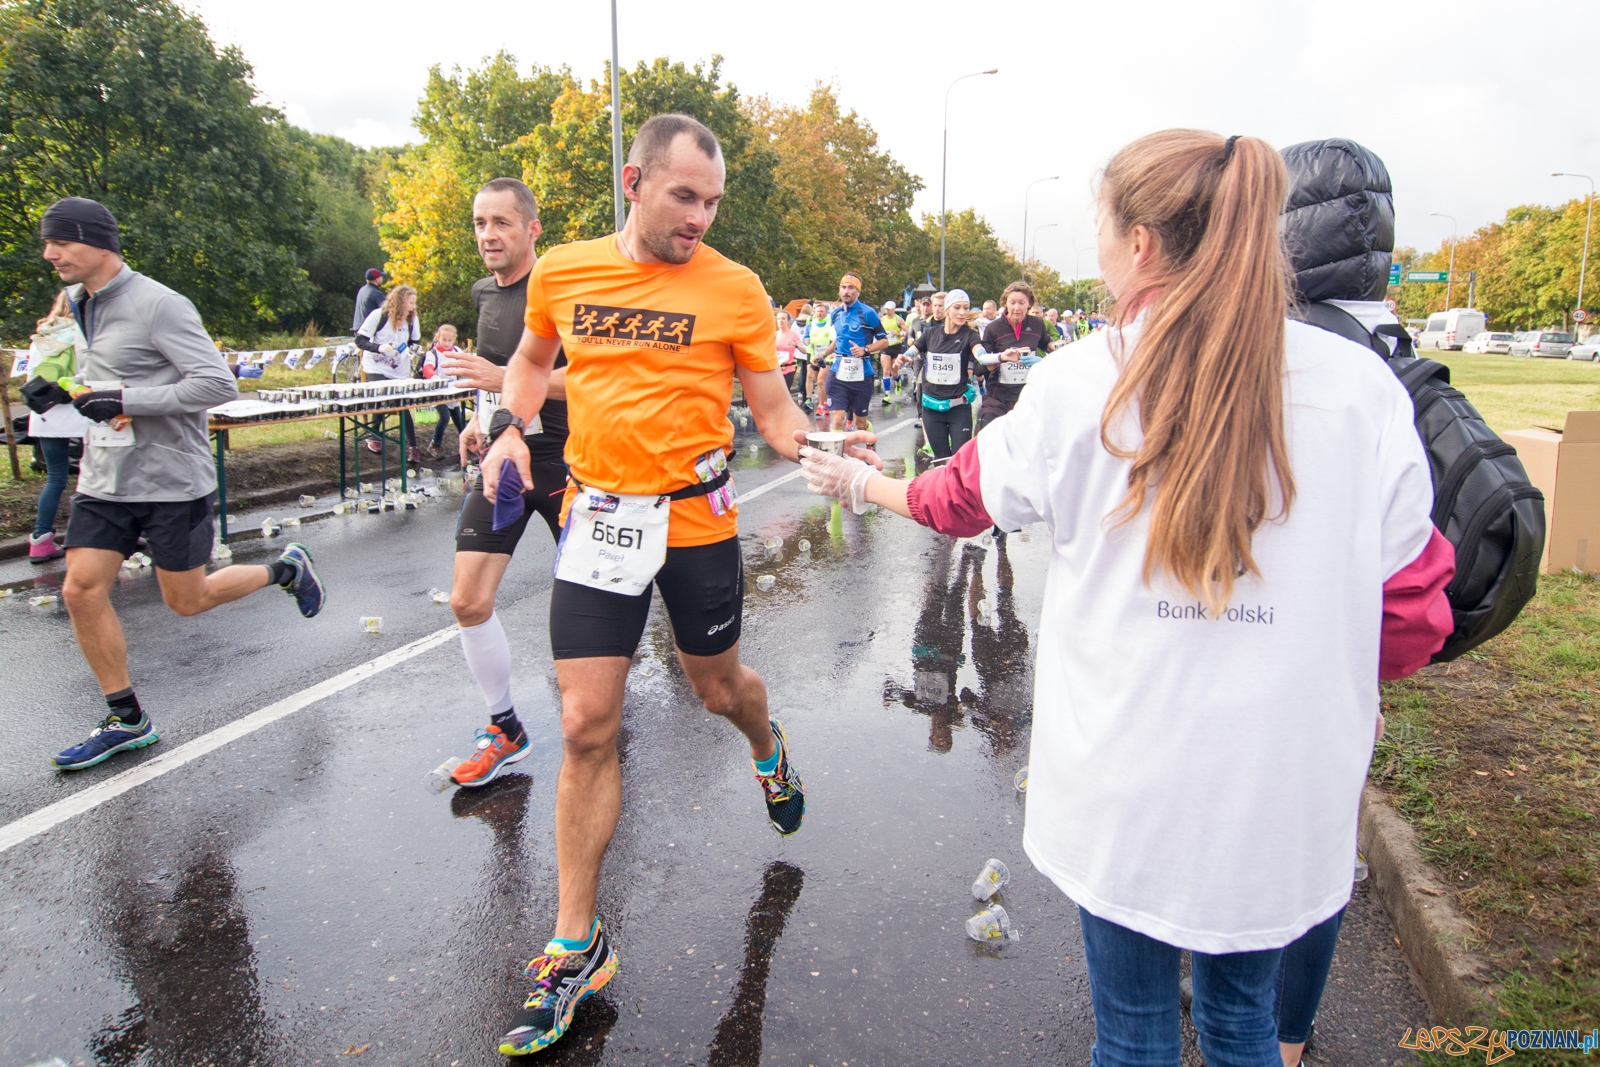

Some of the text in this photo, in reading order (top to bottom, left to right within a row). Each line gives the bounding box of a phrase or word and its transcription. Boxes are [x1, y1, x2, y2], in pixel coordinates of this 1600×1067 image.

[576, 336, 604, 345] YOU'LL
[606, 339, 631, 347] NEVER
[652, 342, 681, 352] ALONE
[932, 363, 954, 372] 6349
[591, 520, 643, 550] 6661
[1157, 600, 1208, 620] Bank
